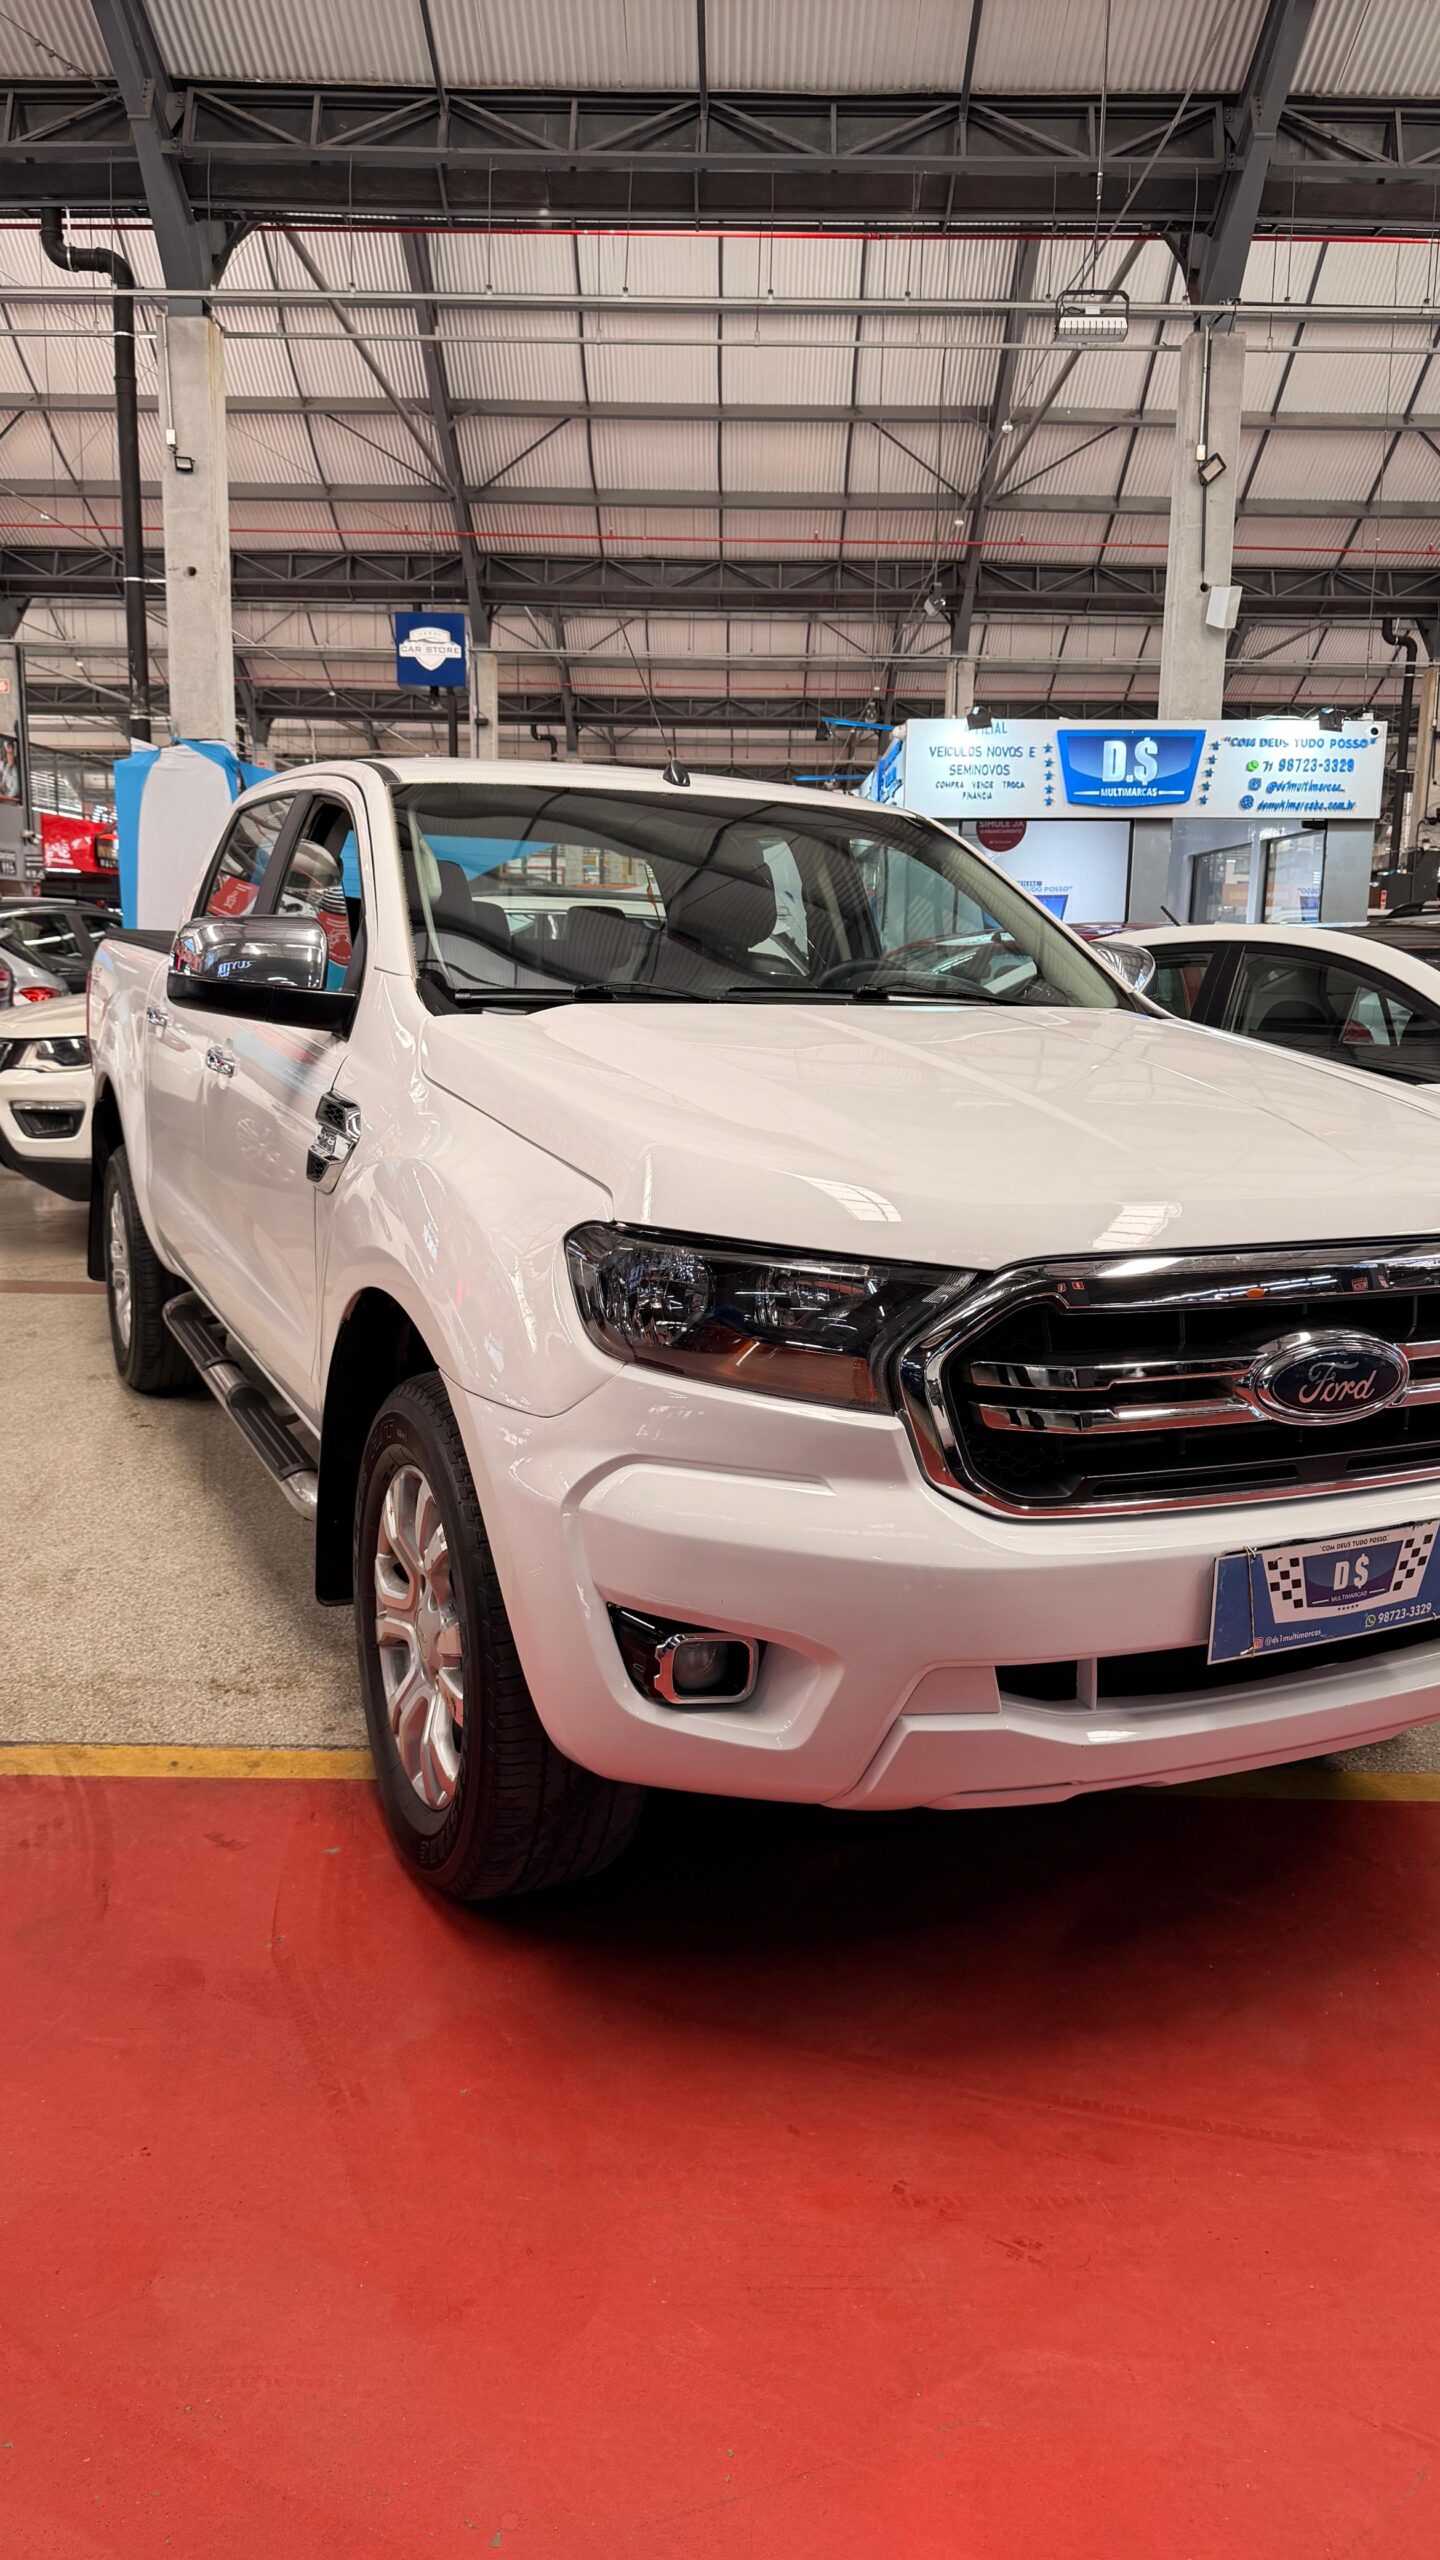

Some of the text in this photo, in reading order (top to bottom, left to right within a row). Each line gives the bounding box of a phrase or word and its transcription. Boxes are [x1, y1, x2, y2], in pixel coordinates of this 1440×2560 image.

[1259, 738, 1289, 748] DEUS
[1294, 738, 1325, 749] TUDO
[986, 746, 1023, 758] NOVOS
[1029, 746, 1037, 758] E
[949, 764, 1011, 776] SEMINOVOS
[1262, 758, 1355, 773] 71 98723-3329
[935, 781, 1025, 789] COMPRA VENDE TROCA
[962, 791, 993, 800] FINANCIA
[1100, 787, 1158, 797] MULTIMARCAS
[979, 820, 1011, 828] SIMULE
[1299, 1361, 1377, 1403] Ford
[1336, 1541, 1351, 1549] DEUS
[1352, 1538, 1368, 1547] TUDO
[1331, 1590, 1368, 1602] MULTIMARCAS
[1378, 1602, 1432, 1624] 98723-3329
